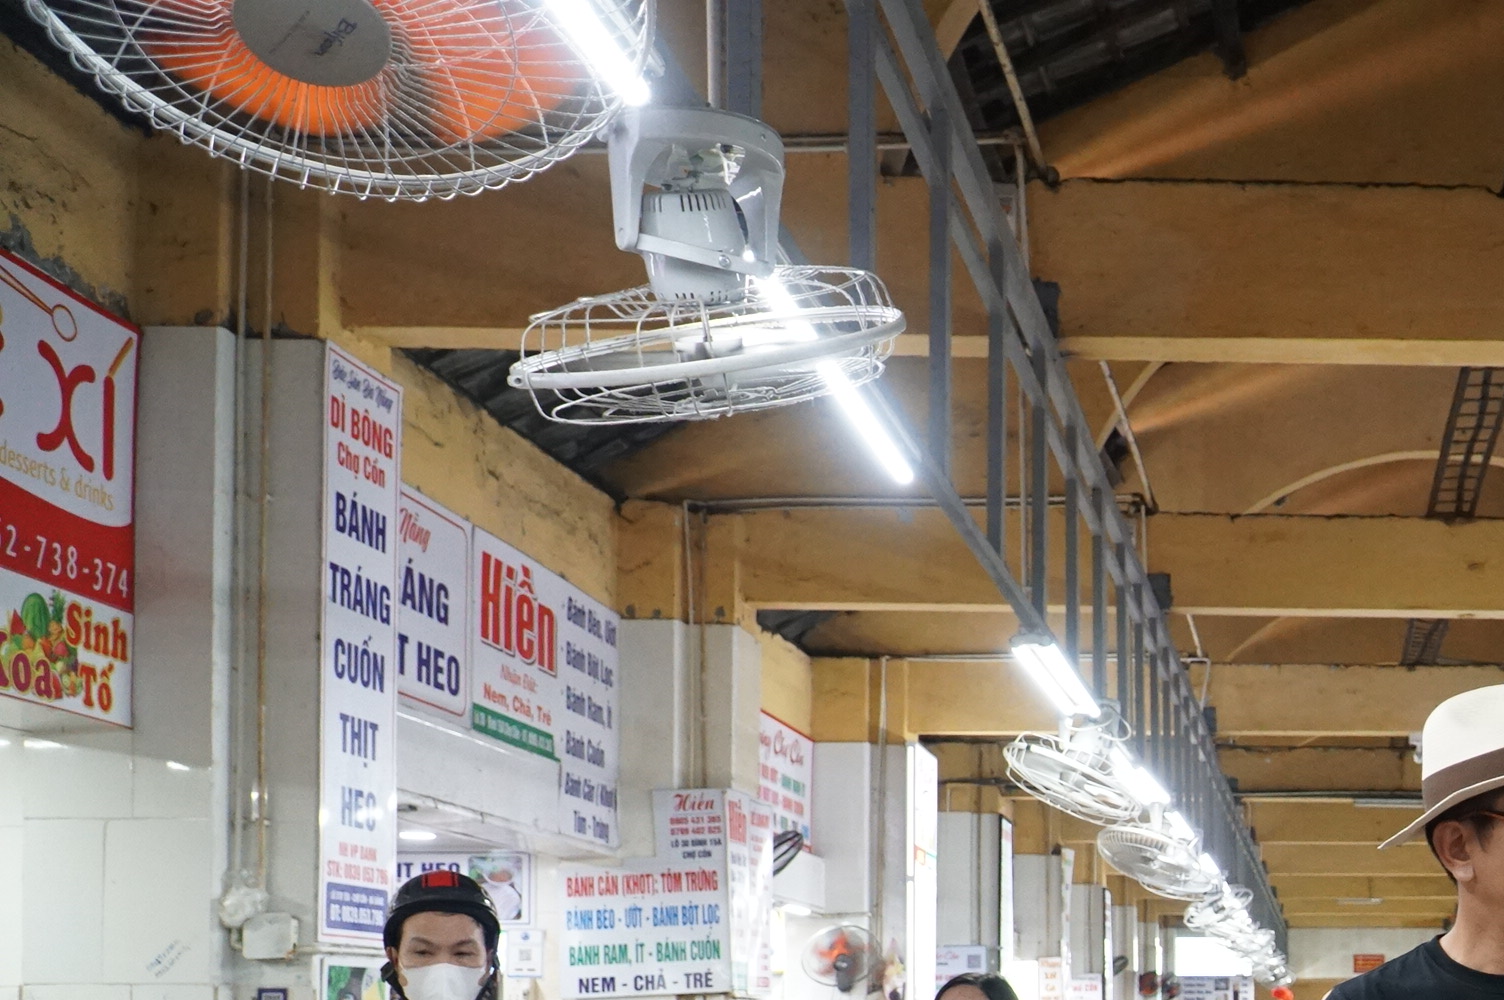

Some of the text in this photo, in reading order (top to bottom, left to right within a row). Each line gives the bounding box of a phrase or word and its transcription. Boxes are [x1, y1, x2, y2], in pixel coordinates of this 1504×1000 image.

[330, 393, 393, 459] DÌ BÔNG
[0, 439, 56, 486] desserts
[74, 474, 114, 511] drinks
[337, 441, 359, 480] Chợ
[336, 490, 386, 553] BÁNH
[0, 518, 129, 598] 2-738-374
[329, 561, 391, 626] TRÁNG
[480, 550, 557, 678] Hiền
[65, 602, 128, 662] Sinh
[79, 663, 114, 713] Tố
[334, 635, 385, 693] CUỐN
[417, 641, 460, 696] HEO
[339, 712, 379, 769] THỊT
[340, 786, 377, 833] HEO
[566, 873, 595, 897] BÁNH
[660, 868, 683, 893] TÔM
[566, 906, 593, 931] BÁNH
[652, 902, 679, 927] BÁNH
[681, 900, 700, 930] BỘT
[702, 903, 721, 930] LỌC
[569, 941, 600, 967] BÁNH
[656, 936, 687, 962] BÁNH
[690, 931, 722, 960] CUỐN
[578, 976, 616, 994] NEM
[633, 968, 667, 991] CHẢ
